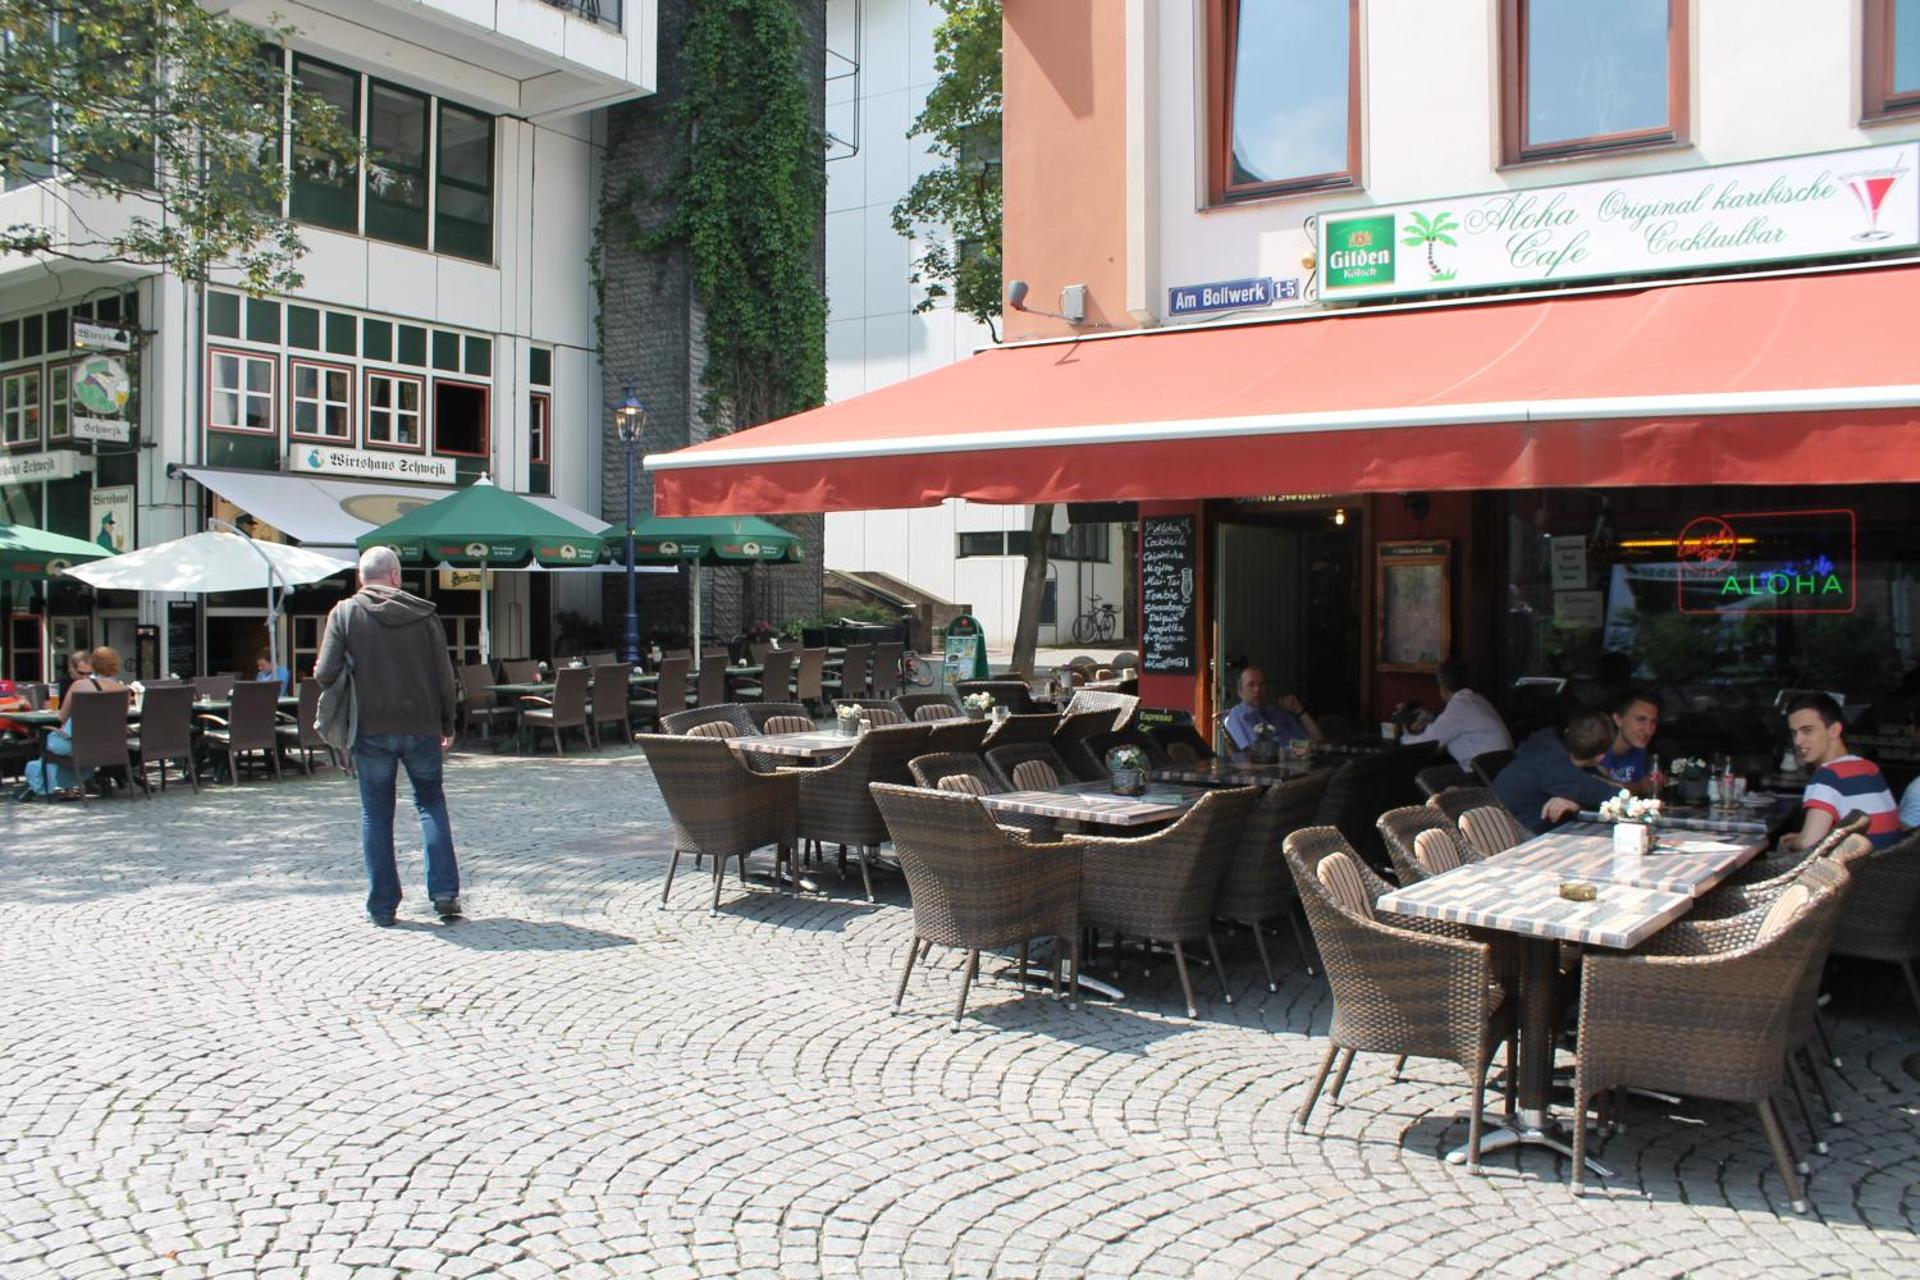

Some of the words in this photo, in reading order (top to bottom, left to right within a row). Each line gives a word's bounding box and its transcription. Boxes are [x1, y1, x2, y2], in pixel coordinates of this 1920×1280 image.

[1464, 192, 1578, 235] Aloha
[1598, 184, 1714, 231] Original
[1713, 170, 1840, 211] karibische
[1643, 216, 1788, 255] Cocktailbar
[1330, 249, 1391, 270] Gilden
[1506, 229, 1591, 277] Cafe
[1175, 290, 1197, 310] Am
[1203, 283, 1265, 307] Bollwerk
[1273, 279, 1297, 300] 1-5
[329, 451, 396, 472] Wirtshaus
[399, 459, 447, 478] Schwejk
[1720, 573, 1844, 596] ALOHA
